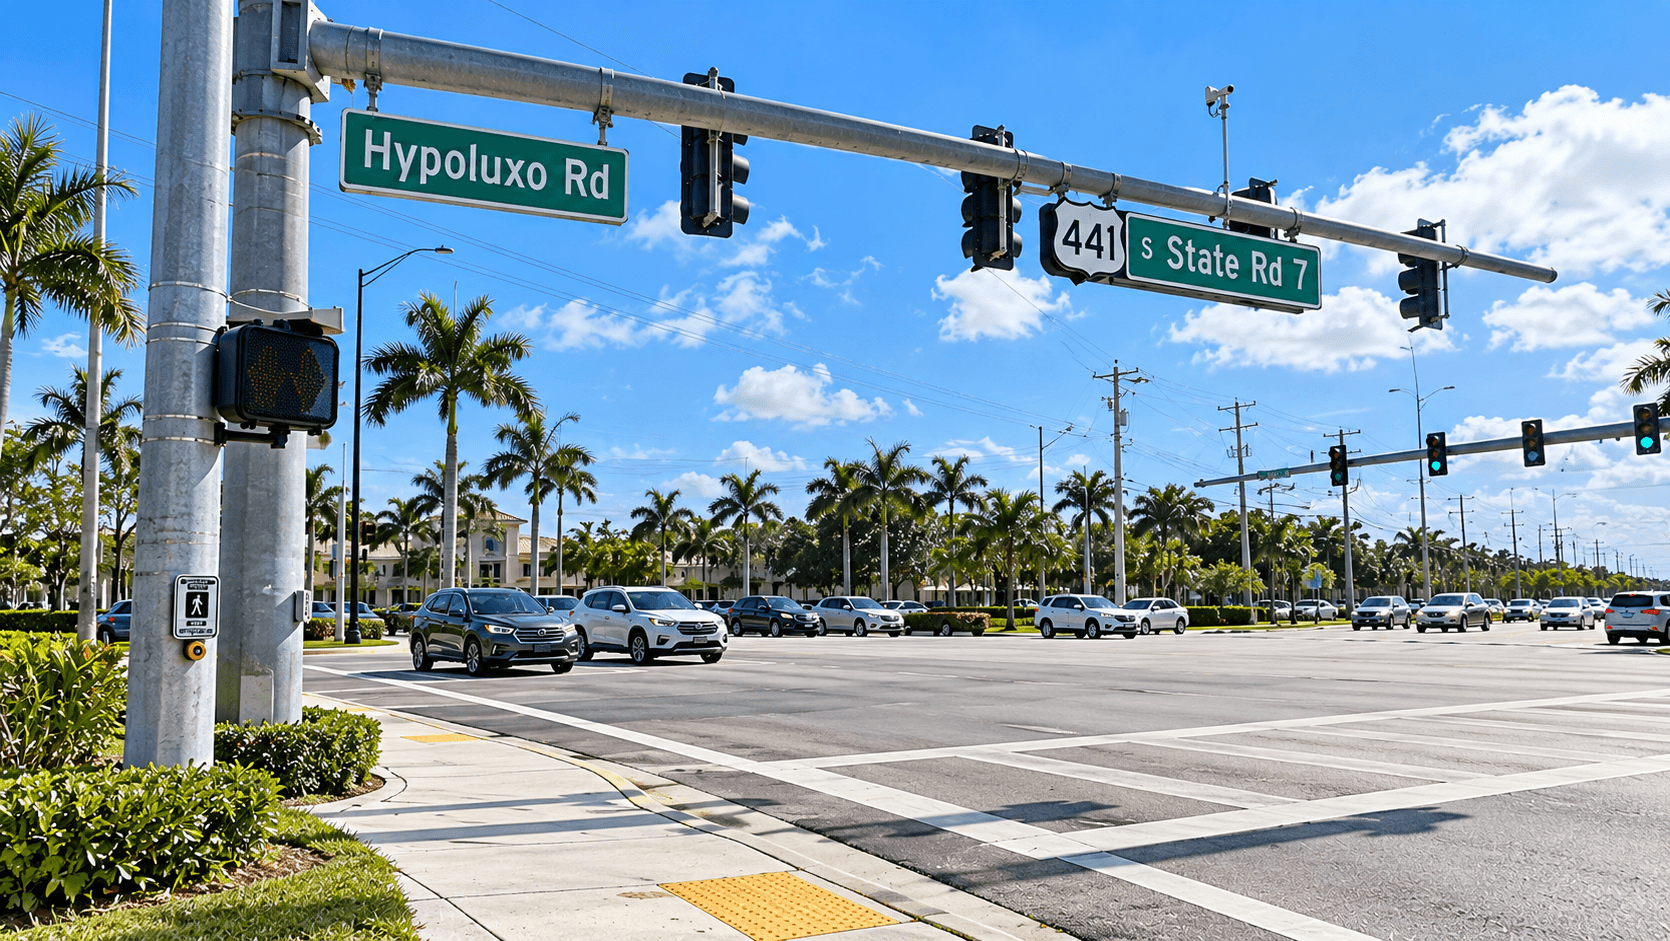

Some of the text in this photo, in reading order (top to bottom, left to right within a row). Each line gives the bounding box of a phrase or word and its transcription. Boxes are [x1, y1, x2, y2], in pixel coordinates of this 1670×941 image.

[364, 128, 609, 200] Hypoluxo Rd
[1062, 219, 1115, 261] 441
[1166, 235, 1239, 280] State
[1251, 250, 1283, 287] Rd
[1293, 258, 1308, 290] 7
